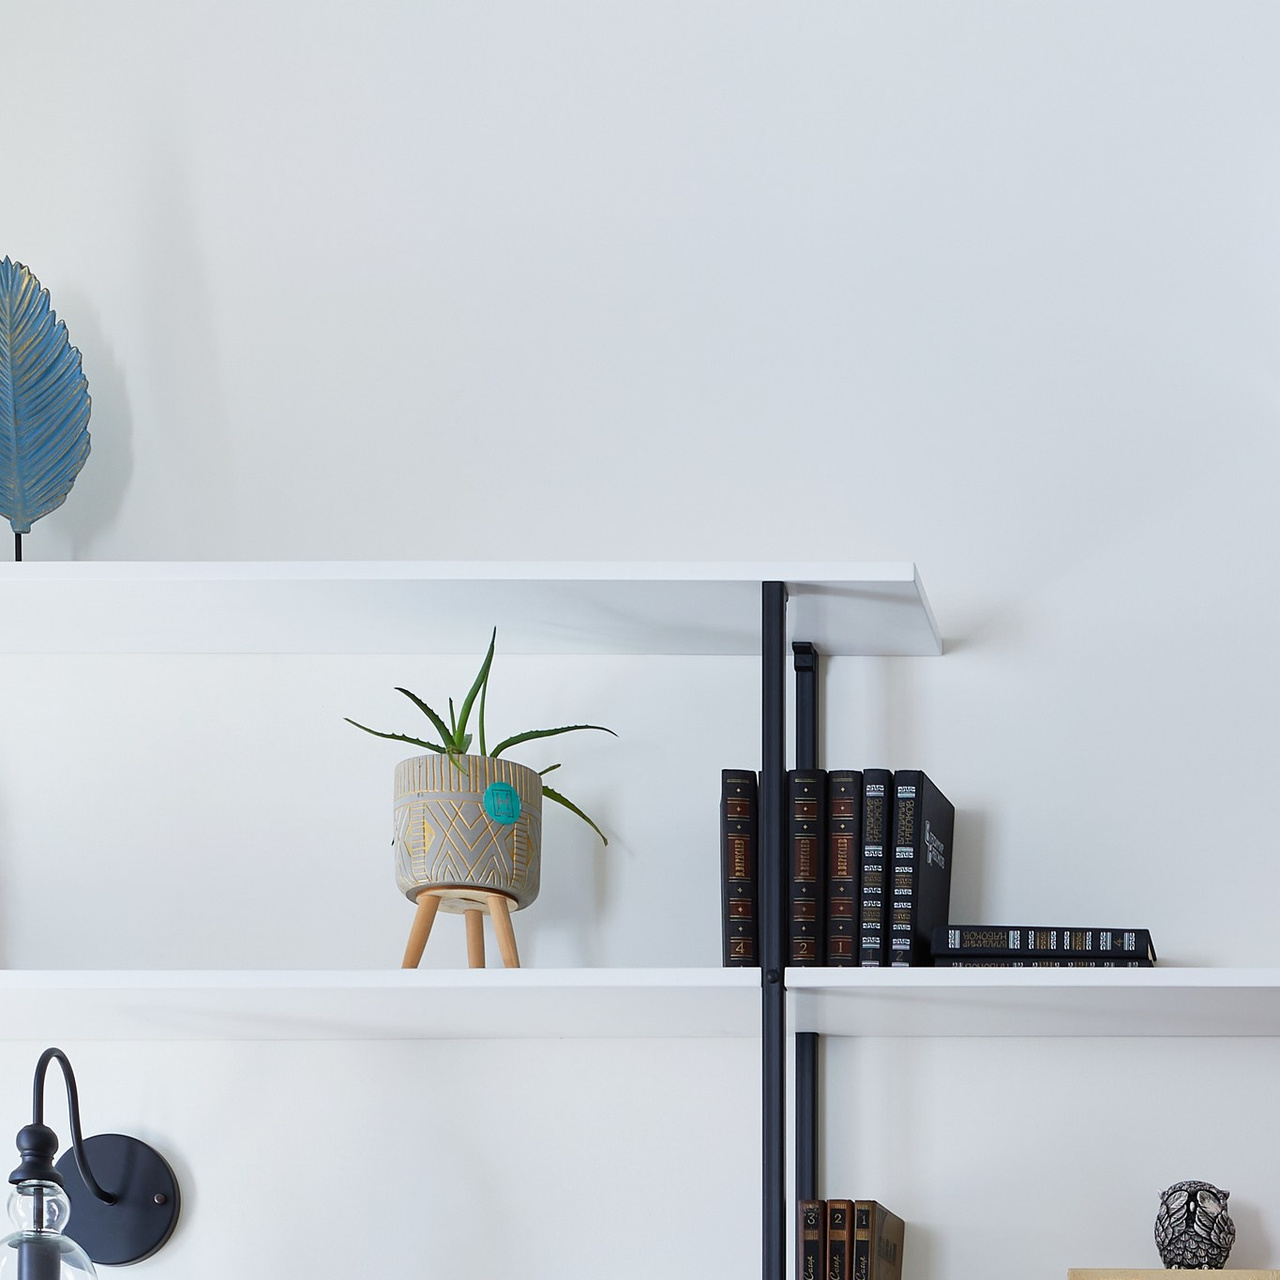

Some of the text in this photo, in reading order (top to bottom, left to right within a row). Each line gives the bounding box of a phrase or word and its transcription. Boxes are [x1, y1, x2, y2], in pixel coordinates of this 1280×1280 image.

[866, 798, 874, 842] ВЛАДИМИР
[874, 798, 883, 842] НАБОКОВ
[896, 800, 905, 844] ВЛАДИМИР
[904, 800, 914, 844] НАБОКОВ
[735, 943, 744, 953] 4
[800, 943, 808, 953] 2
[838, 942, 843, 952] 1
[962, 939, 1007, 947] ВЛАДИМИР
[897, 950, 903, 961] 2
[807, 1212, 815, 1224] 3
[834, 1213, 842, 1224] 2
[862, 1215, 866, 1224] 1
